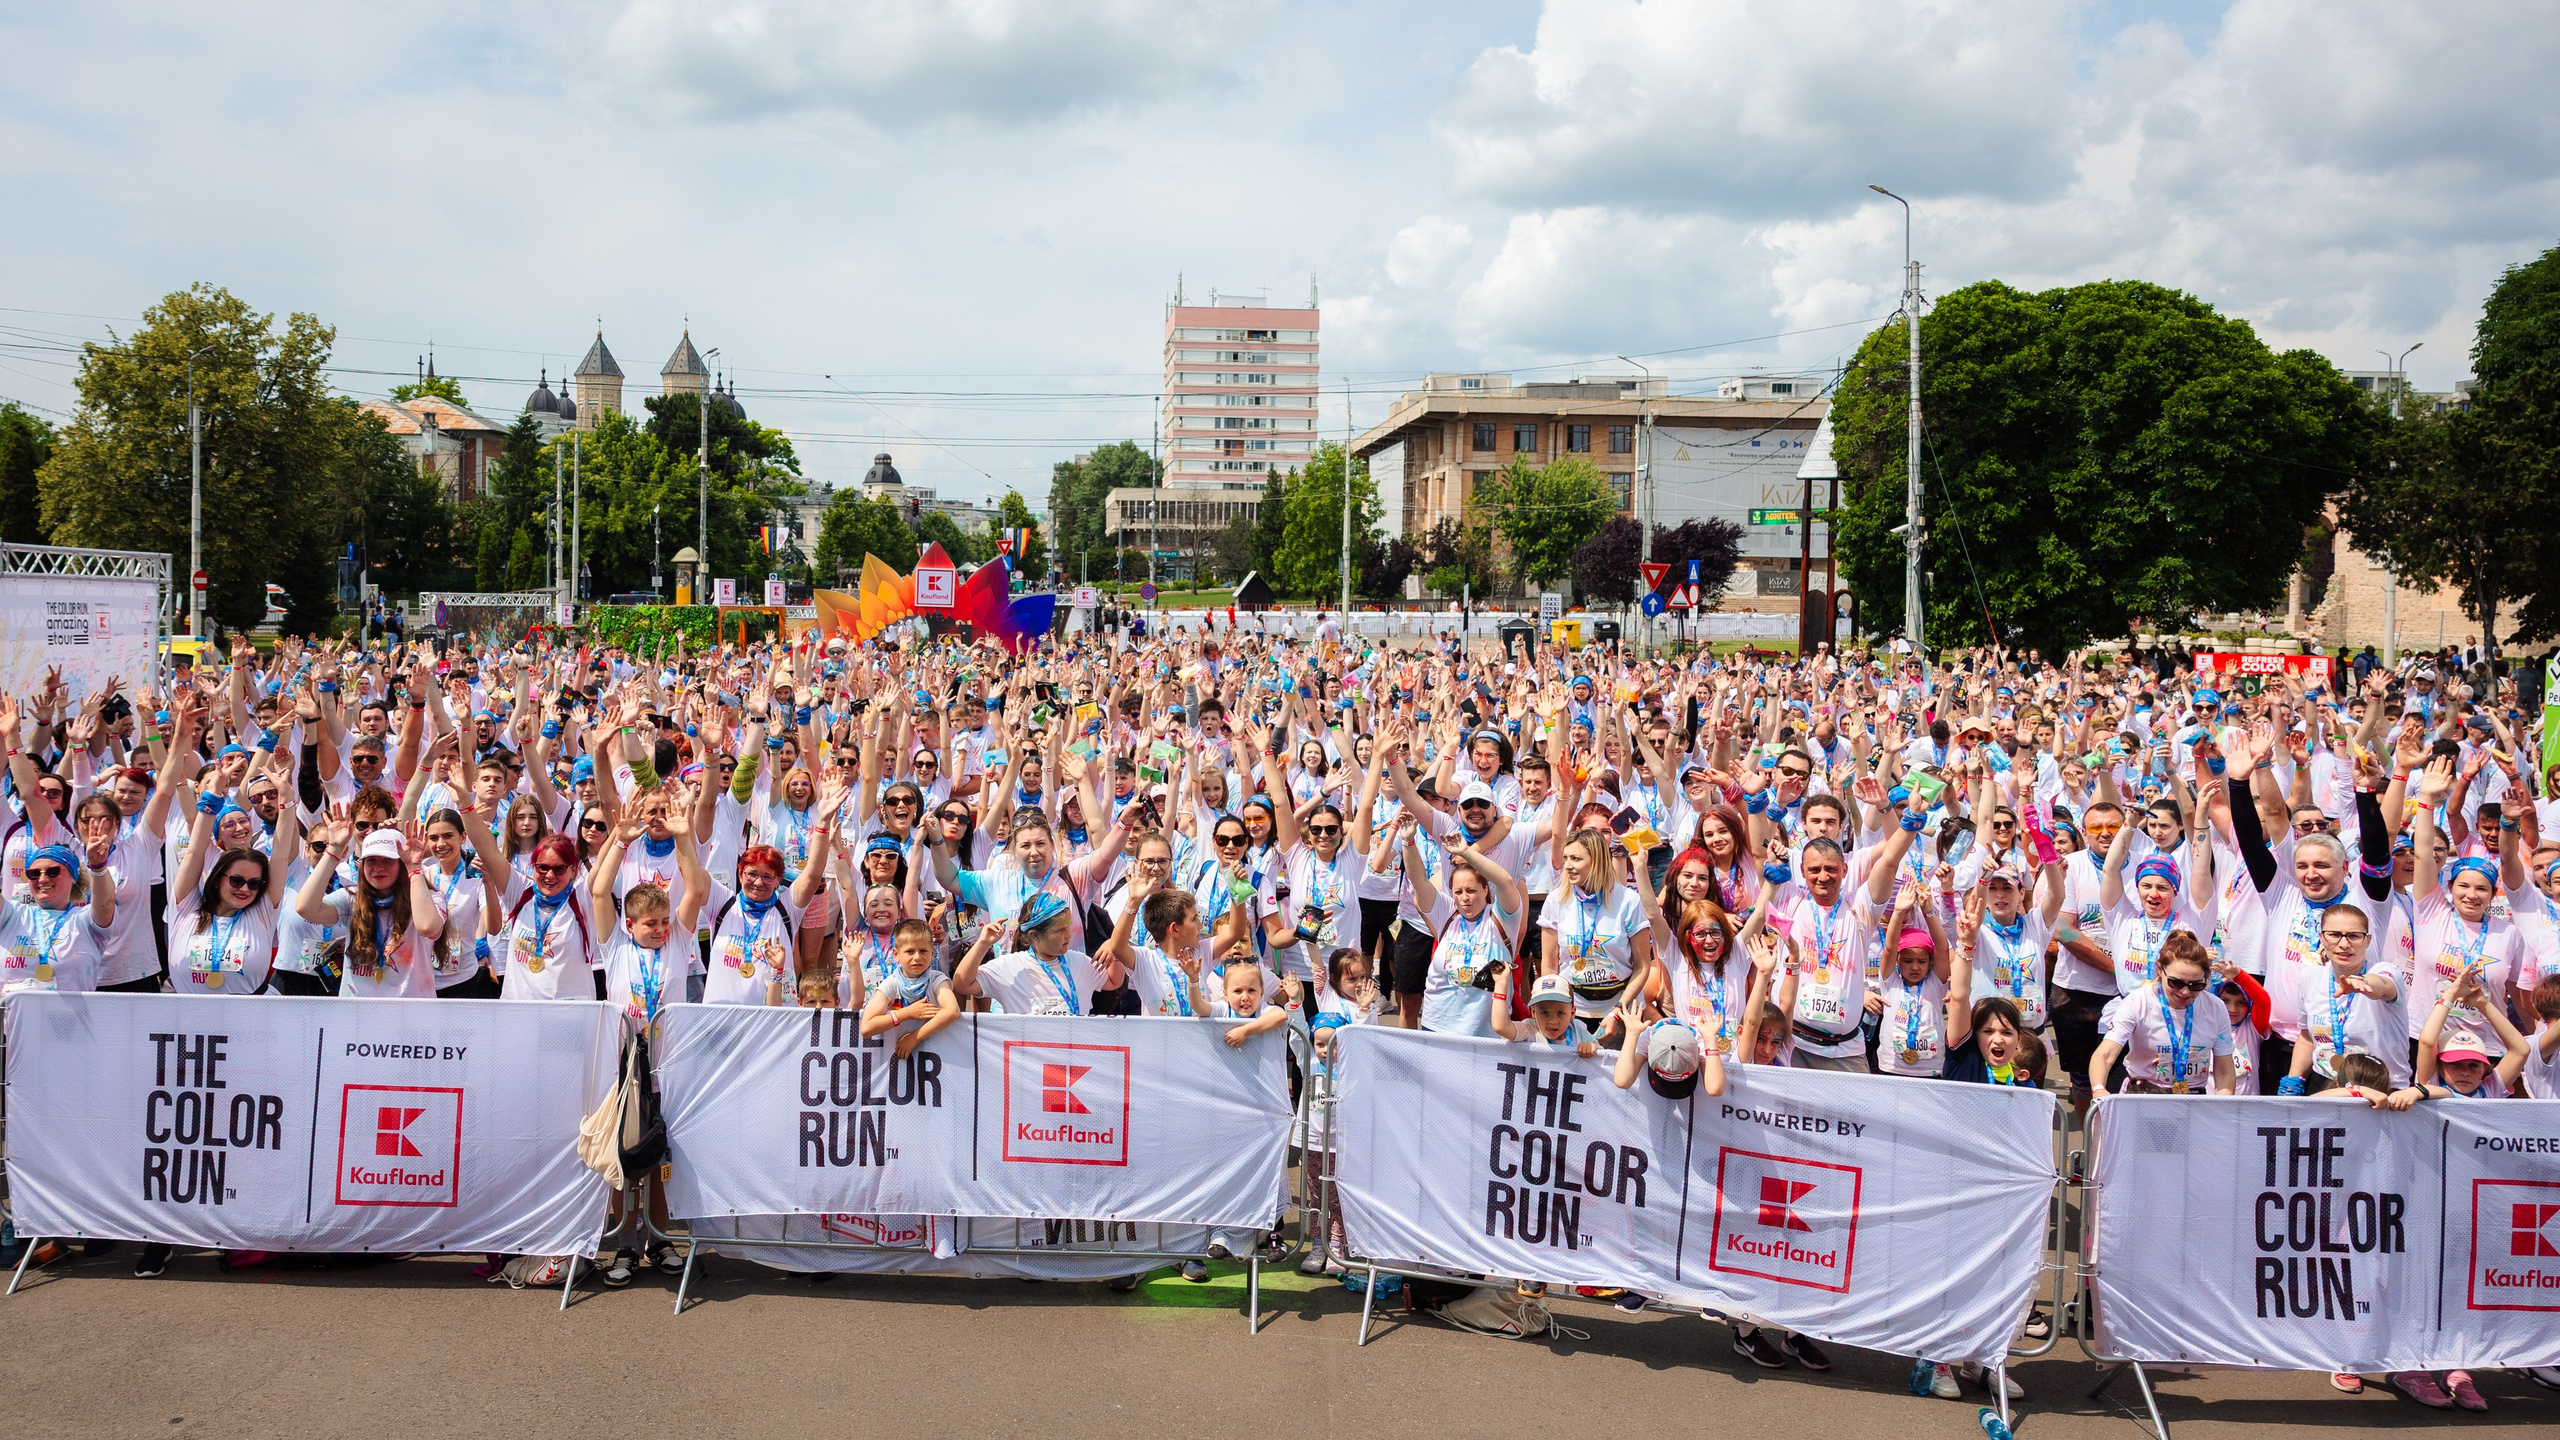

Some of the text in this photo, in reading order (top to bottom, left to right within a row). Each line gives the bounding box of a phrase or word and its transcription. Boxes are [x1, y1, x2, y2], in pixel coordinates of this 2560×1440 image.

[1765, 511, 1798, 520] ADMITER
[920, 592, 949, 600] Kaufland
[46, 602, 57, 615] THE
[58, 602, 76, 615] COLOR
[46, 616, 89, 633] amazing
[54, 632, 74, 645] tour
[369, 838, 395, 847] ARCADIS
[12, 849, 26, 859] THE
[2086, 903, 2101, 914] THE
[2485, 906, 2505, 916] 8986
[16, 935, 29, 946] THE
[520, 927, 535, 940] THE
[729, 934, 745, 947] THE
[1566, 935, 1581, 944] THE
[514, 937, 537, 951] COLO
[1803, 936, 1818, 947] THE
[2286, 938, 2309, 955] COLO
[9, 946, 39, 957] COLOR
[204, 949, 231, 962] 1824
[725, 944, 746, 958] COL
[1566, 945, 1593, 955] COLR
[1800, 947, 1818, 959] COL
[2442, 942, 2460, 956] THE
[514, 950, 530, 964] RUN
[724, 954, 742, 970] RUN
[1869, 957, 1881, 967] HE
[2126, 950, 2149, 964] COLO
[2437, 952, 2464, 970] COLO
[1800, 961, 1818, 976] RUN
[1994, 967, 2012, 979] COL
[2125, 959, 2143, 974] RUN
[1583, 969, 1607, 983] 18132
[1812, 998, 1837, 1014] 15734
[2312, 1014, 2327, 1026] THE
[2312, 1025, 2332, 1036] COLO
[346, 1043, 467, 1061] POWERED BY
[1905, 1039, 1928, 1051] 1030
[2157, 1045, 2172, 1054] THE
[149, 1033, 228, 1089] THE
[2172, 1062, 2199, 1076] 161
[800, 1051, 943, 1108] COLOR
[1497, 1062, 1587, 1132] THE
[145, 1089, 284, 1151] COLOR
[1721, 1104, 1867, 1137] POWERED BY
[799, 1110, 886, 1167] RUN
[1017, 1123, 1114, 1144] Kaufland
[2474, 1136, 2560, 1154] POWERE
[2256, 1127, 2346, 1188] THE
[1489, 1124, 1648, 1208] COLOR
[143, 1147, 227, 1205] RUN
[350, 1167, 444, 1186] Kaufland
[1486, 1180, 1581, 1250] RUN
[2255, 1191, 2406, 1254] COLOR
[1727, 1233, 1836, 1269] Kaufland
[2484, 1268, 2560, 1288] Kaufla
[2255, 1257, 2356, 1322] RUN
